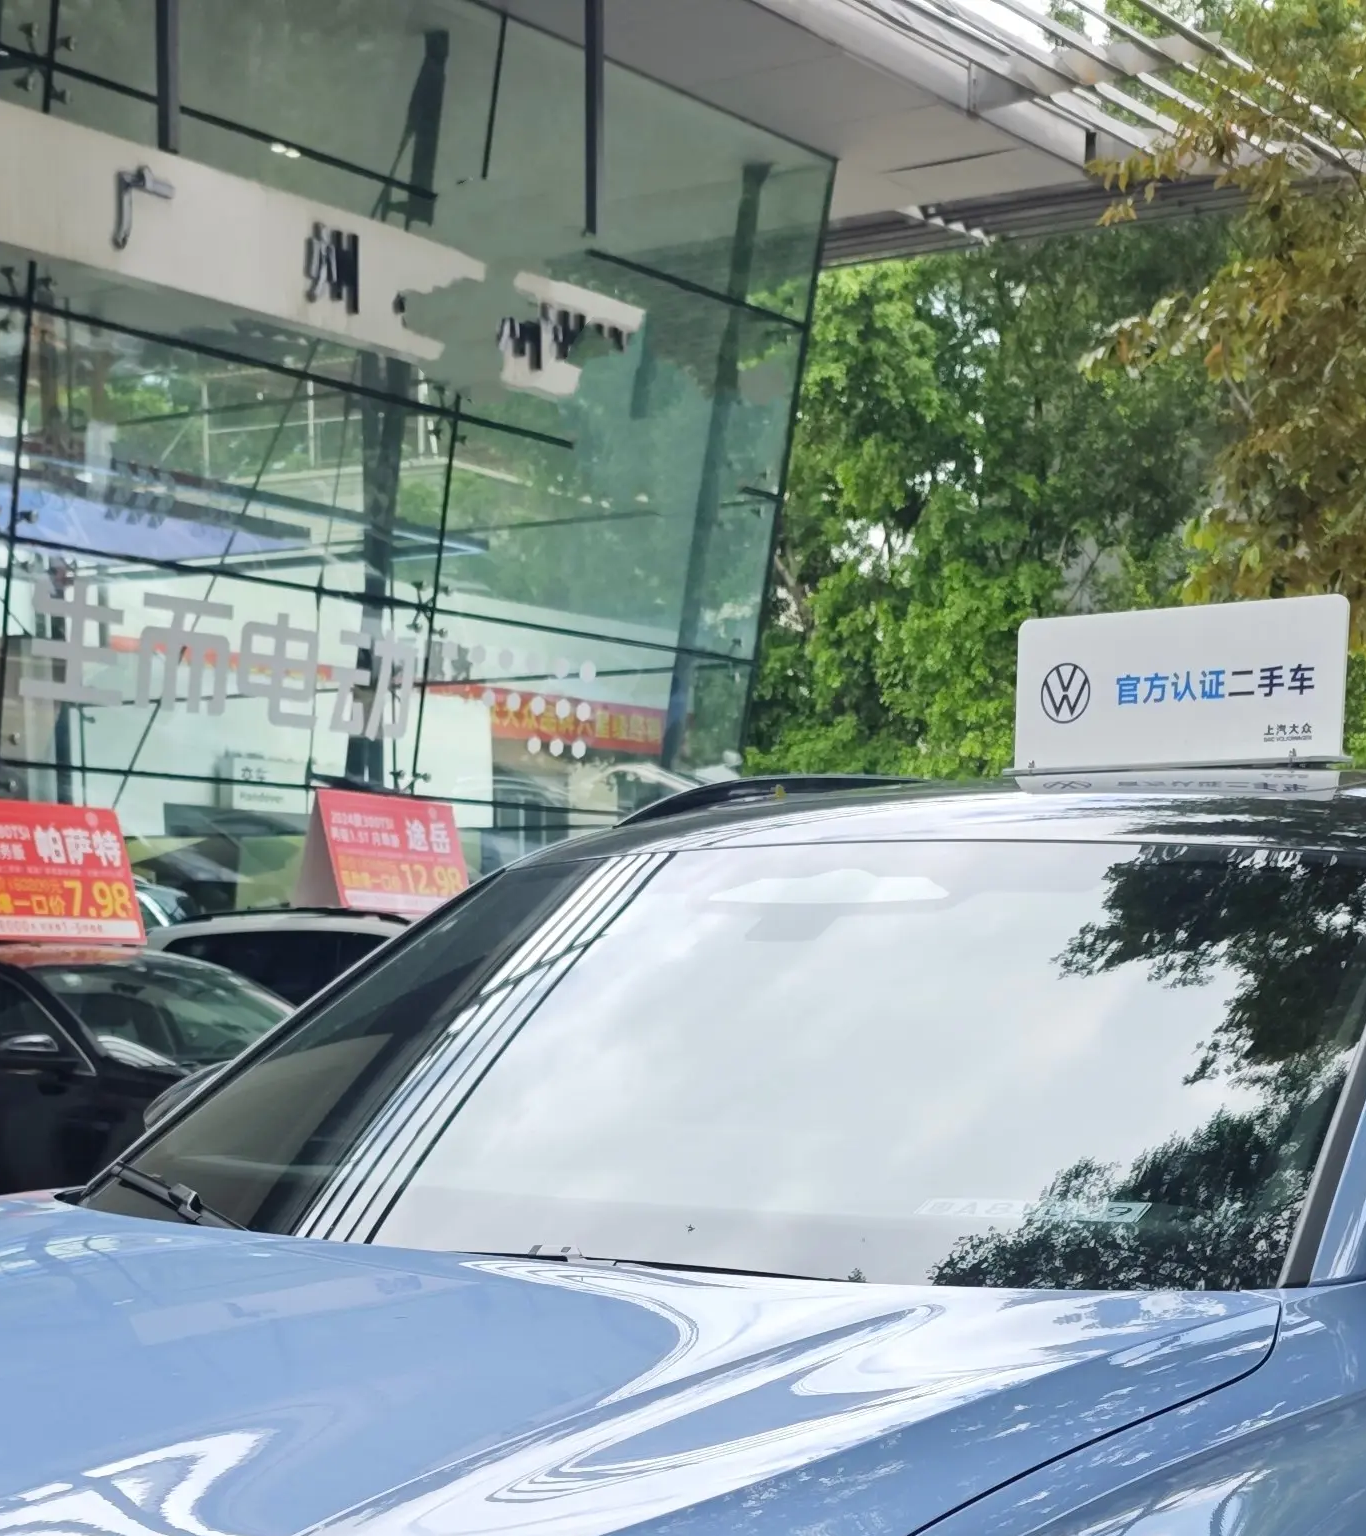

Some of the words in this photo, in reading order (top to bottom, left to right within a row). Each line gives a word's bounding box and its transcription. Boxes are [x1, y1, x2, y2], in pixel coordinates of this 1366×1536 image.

[19, 580, 419, 740] 生而电动
[1116, 663, 1316, 706] 官方认证二手车
[1263, 722, 1312, 736] 上汽大众
[34, 824, 120, 867] 帕萨特
